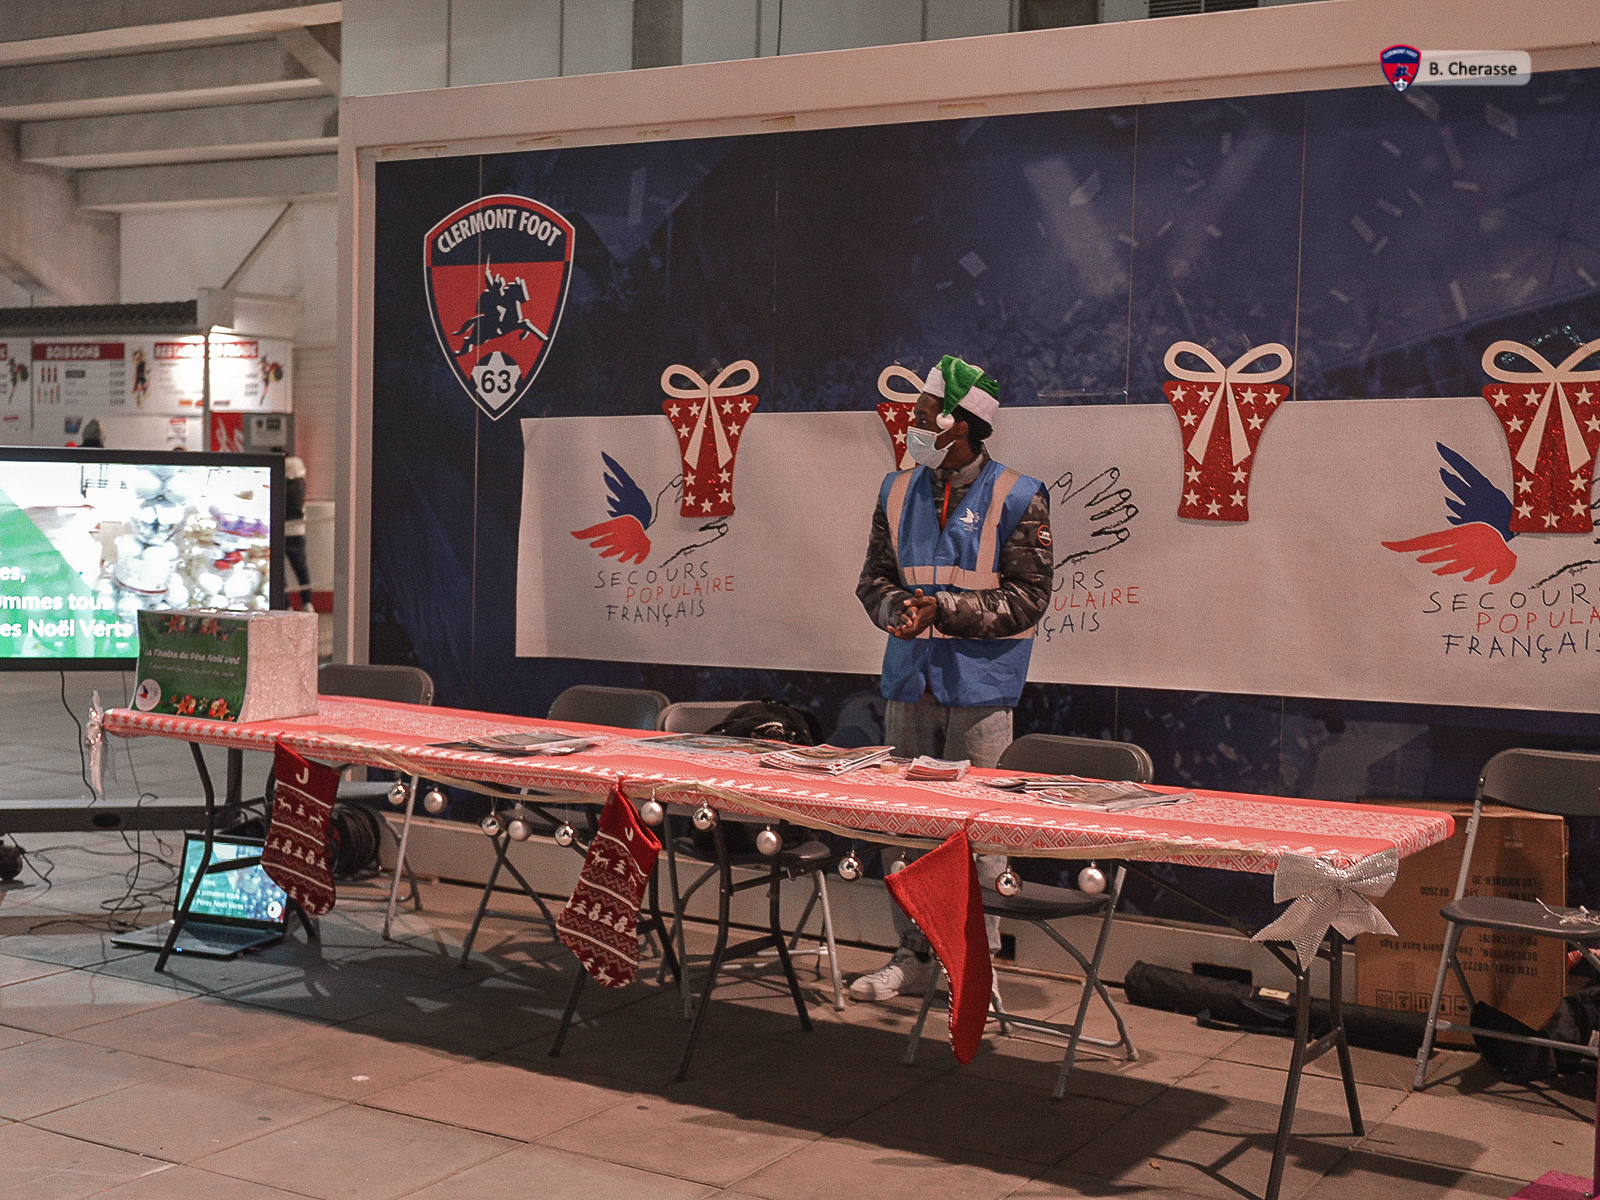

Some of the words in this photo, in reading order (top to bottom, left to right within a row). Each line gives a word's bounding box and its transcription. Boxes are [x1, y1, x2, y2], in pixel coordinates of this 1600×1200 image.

[437, 208, 517, 253] CLERMONT
[518, 211, 562, 247] FOOT
[481, 369, 512, 394] 63
[594, 561, 708, 589] SECOURS
[0, 596, 63, 610] mmes
[626, 575, 735, 604] POPULAIRE
[1054, 586, 1140, 611] ULAIRE
[1423, 583, 1600, 613] SECOUR
[606, 599, 705, 627] FRANÇAIS
[28, 619, 75, 637] Noël
[79, 619, 134, 637] Verts
[1442, 629, 1600, 664] FRANÇAI
